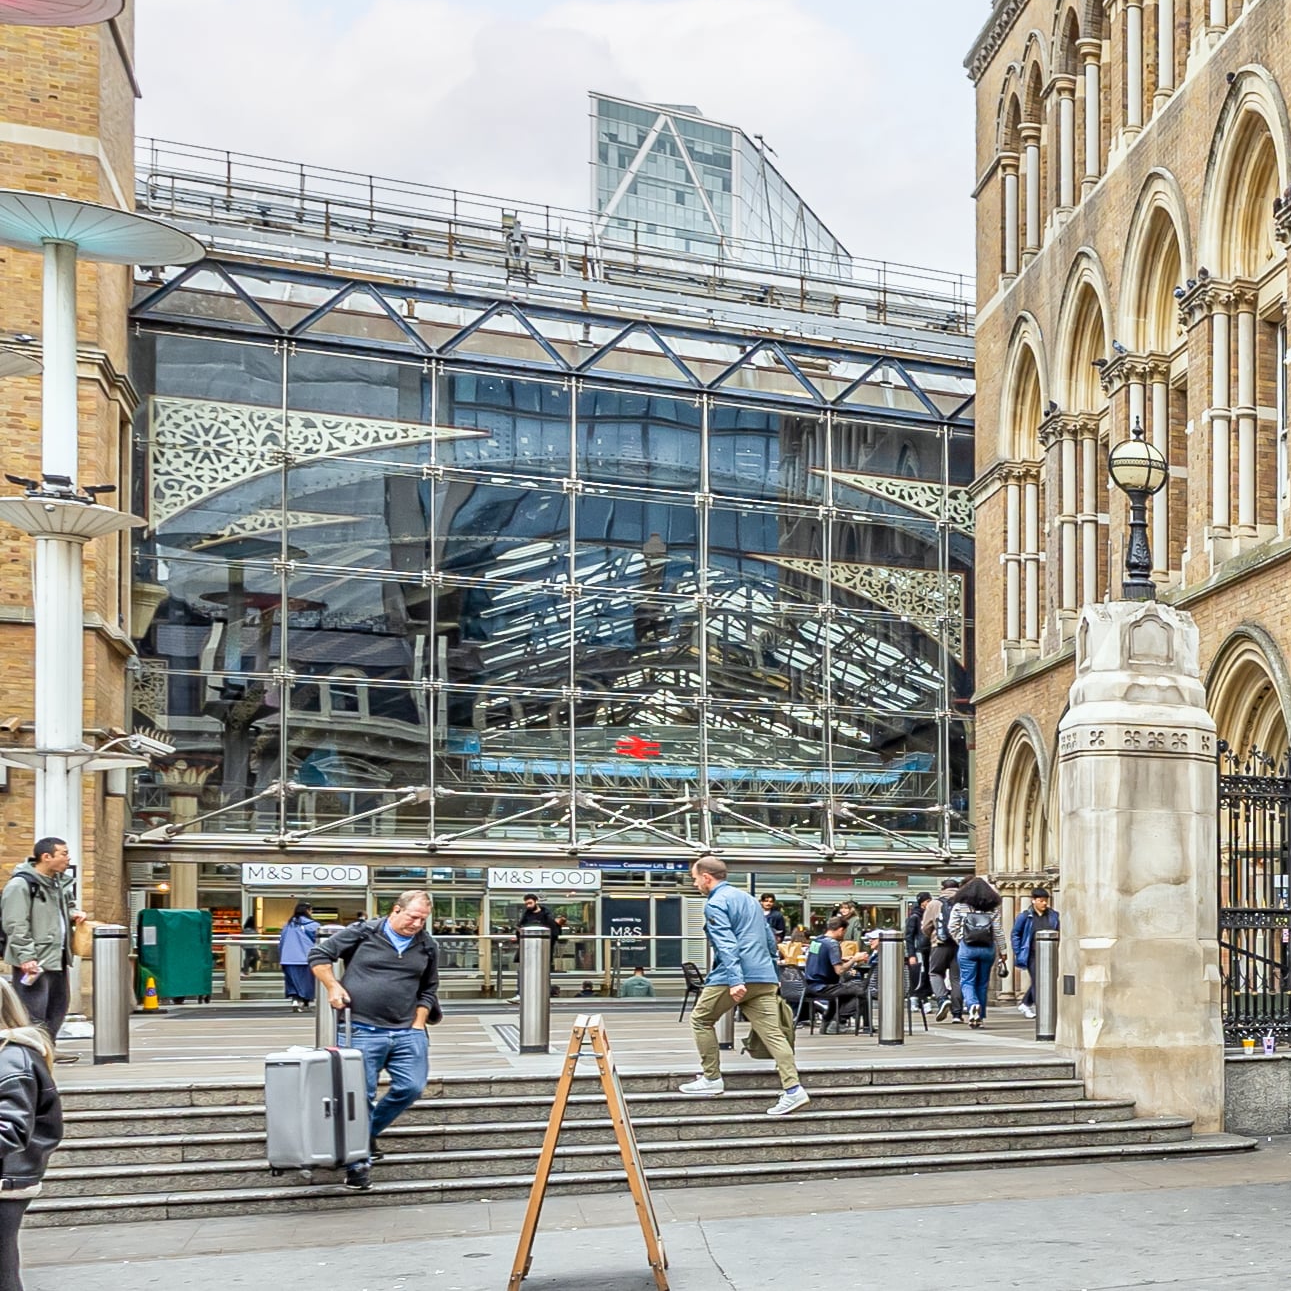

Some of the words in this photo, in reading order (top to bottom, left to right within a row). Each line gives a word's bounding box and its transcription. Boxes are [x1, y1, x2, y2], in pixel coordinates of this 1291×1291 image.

[248, 866, 293, 880] M&S
[301, 866, 362, 881] FOOD
[493, 870, 534, 884] M&S
[540, 871, 596, 885] FOOD
[854, 877, 899, 887] Flowers
[610, 926, 642, 937] M&S
